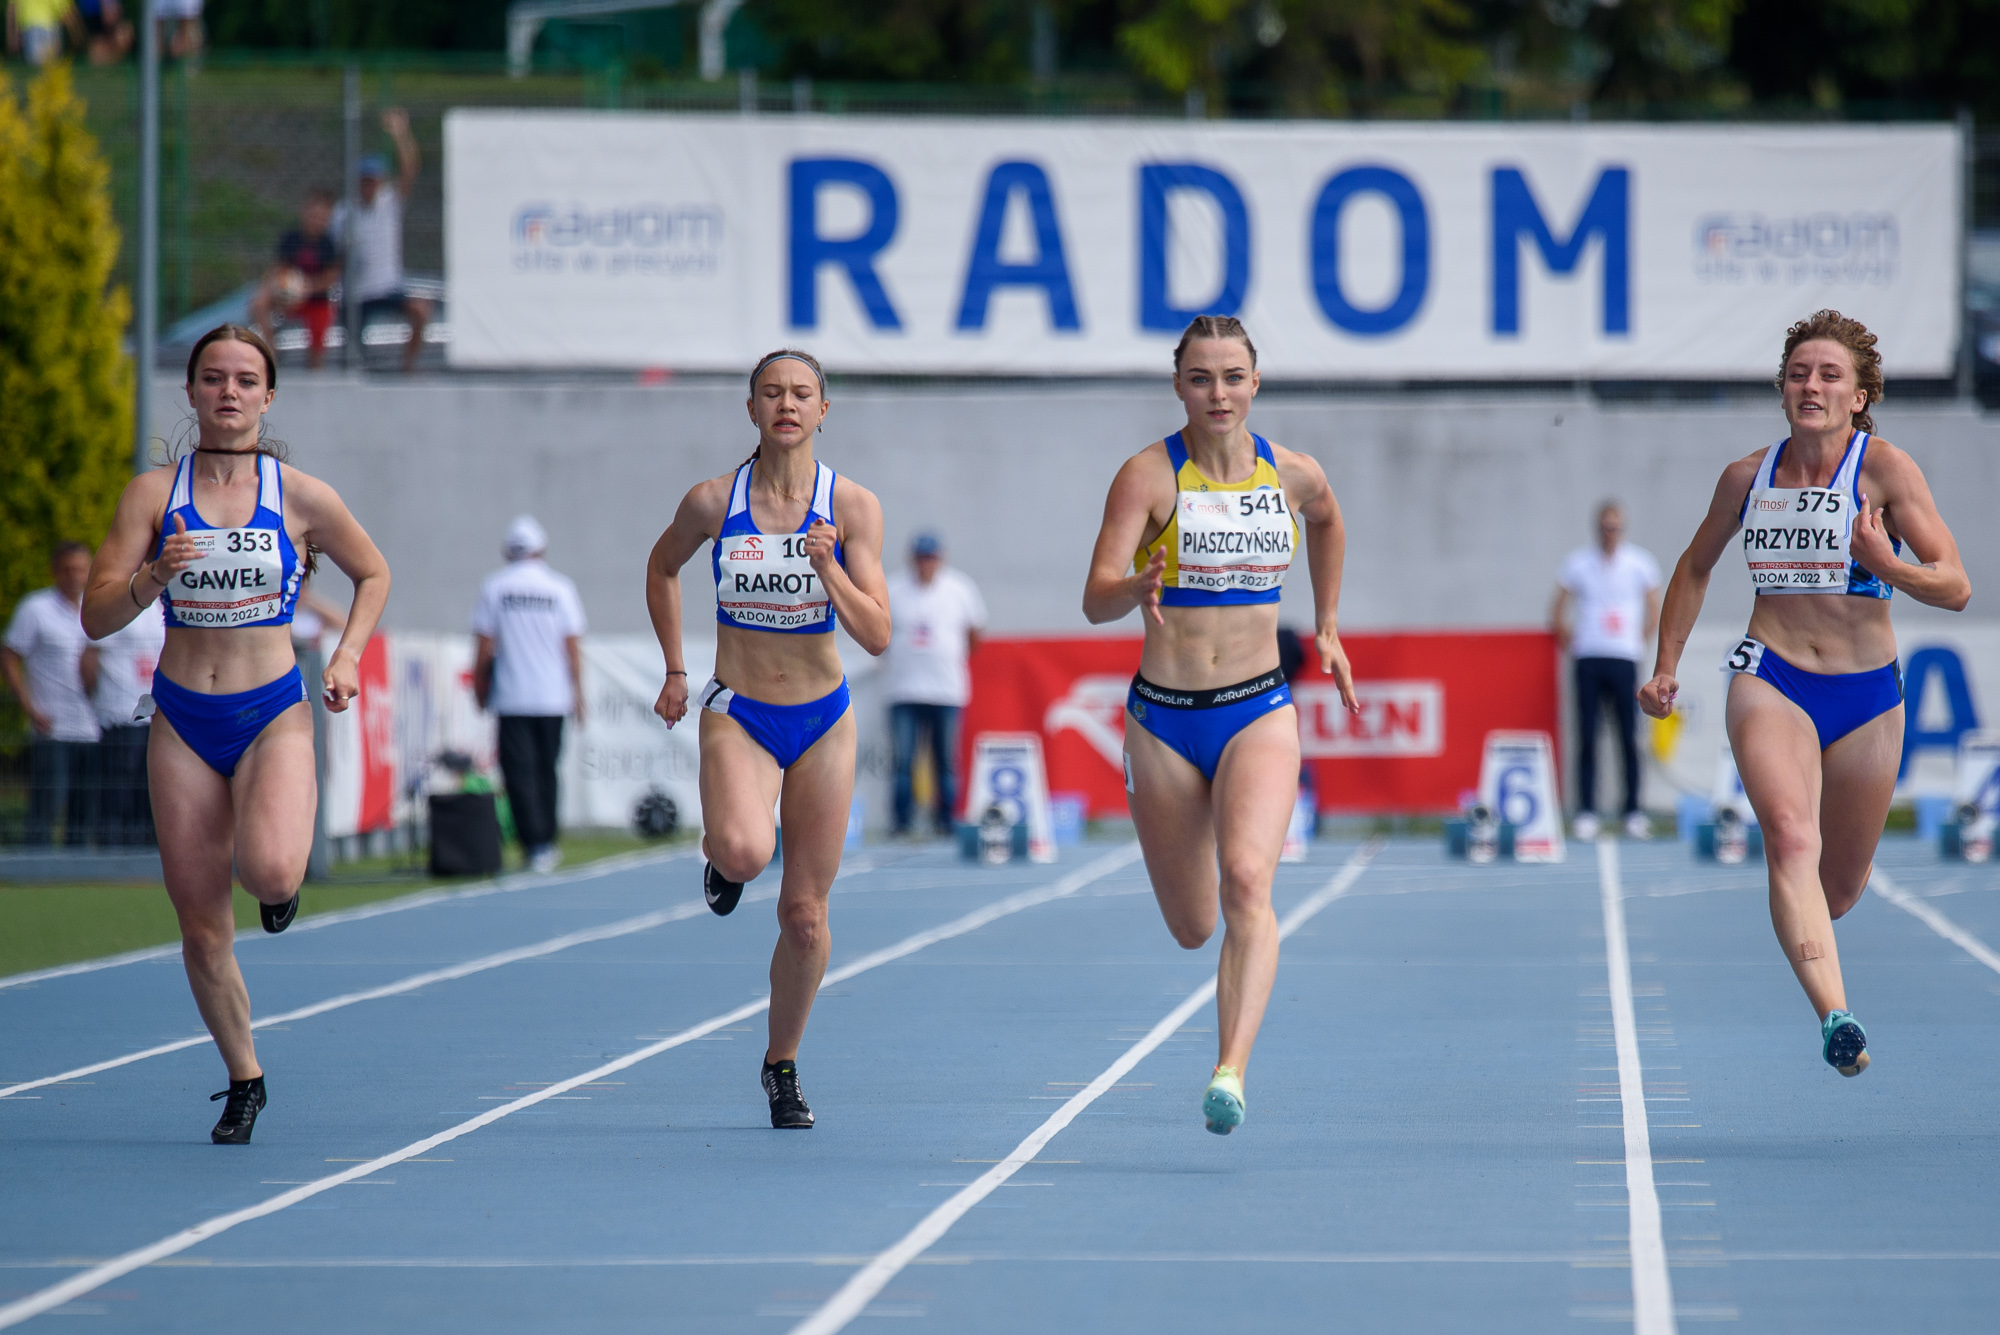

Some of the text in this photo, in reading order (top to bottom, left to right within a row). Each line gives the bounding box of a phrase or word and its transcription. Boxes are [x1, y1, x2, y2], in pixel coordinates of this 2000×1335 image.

[785, 158, 1630, 338] RADOM
[1198, 502, 1229, 514] mosir
[1240, 493, 1285, 516] 541
[1760, 499, 1789, 510] mosir
[1796, 491, 1841, 513] 575
[227, 532, 272, 552] 353
[1183, 527, 1290, 554] PIASZCZYŃSKA
[1744, 528, 1839, 550] PRZYBYŁ
[731, 551, 762, 559] ORLEN
[180, 568, 267, 590] GAWEŁ
[735, 573, 816, 594] RAROT
[1188, 575, 1268, 587] RADOM 2022
[1752, 573, 1821, 584] ADOM 2022
[240, 597, 263, 606] POLSKI
[741, 602, 789, 612] MISTRZOSTWA
[180, 607, 260, 623] RADOM 2022
[730, 610, 807, 625] RADOM 2022
[1728, 640, 1757, 671] 5
[704, 678, 728, 707] 7
[1136, 683, 1194, 706] AdRunaLine
[1213, 677, 1275, 704] AdRunaLine
[1300, 700, 1421, 741] LEN
[991, 766, 1026, 827] 8
[1498, 766, 1539, 828] 6
